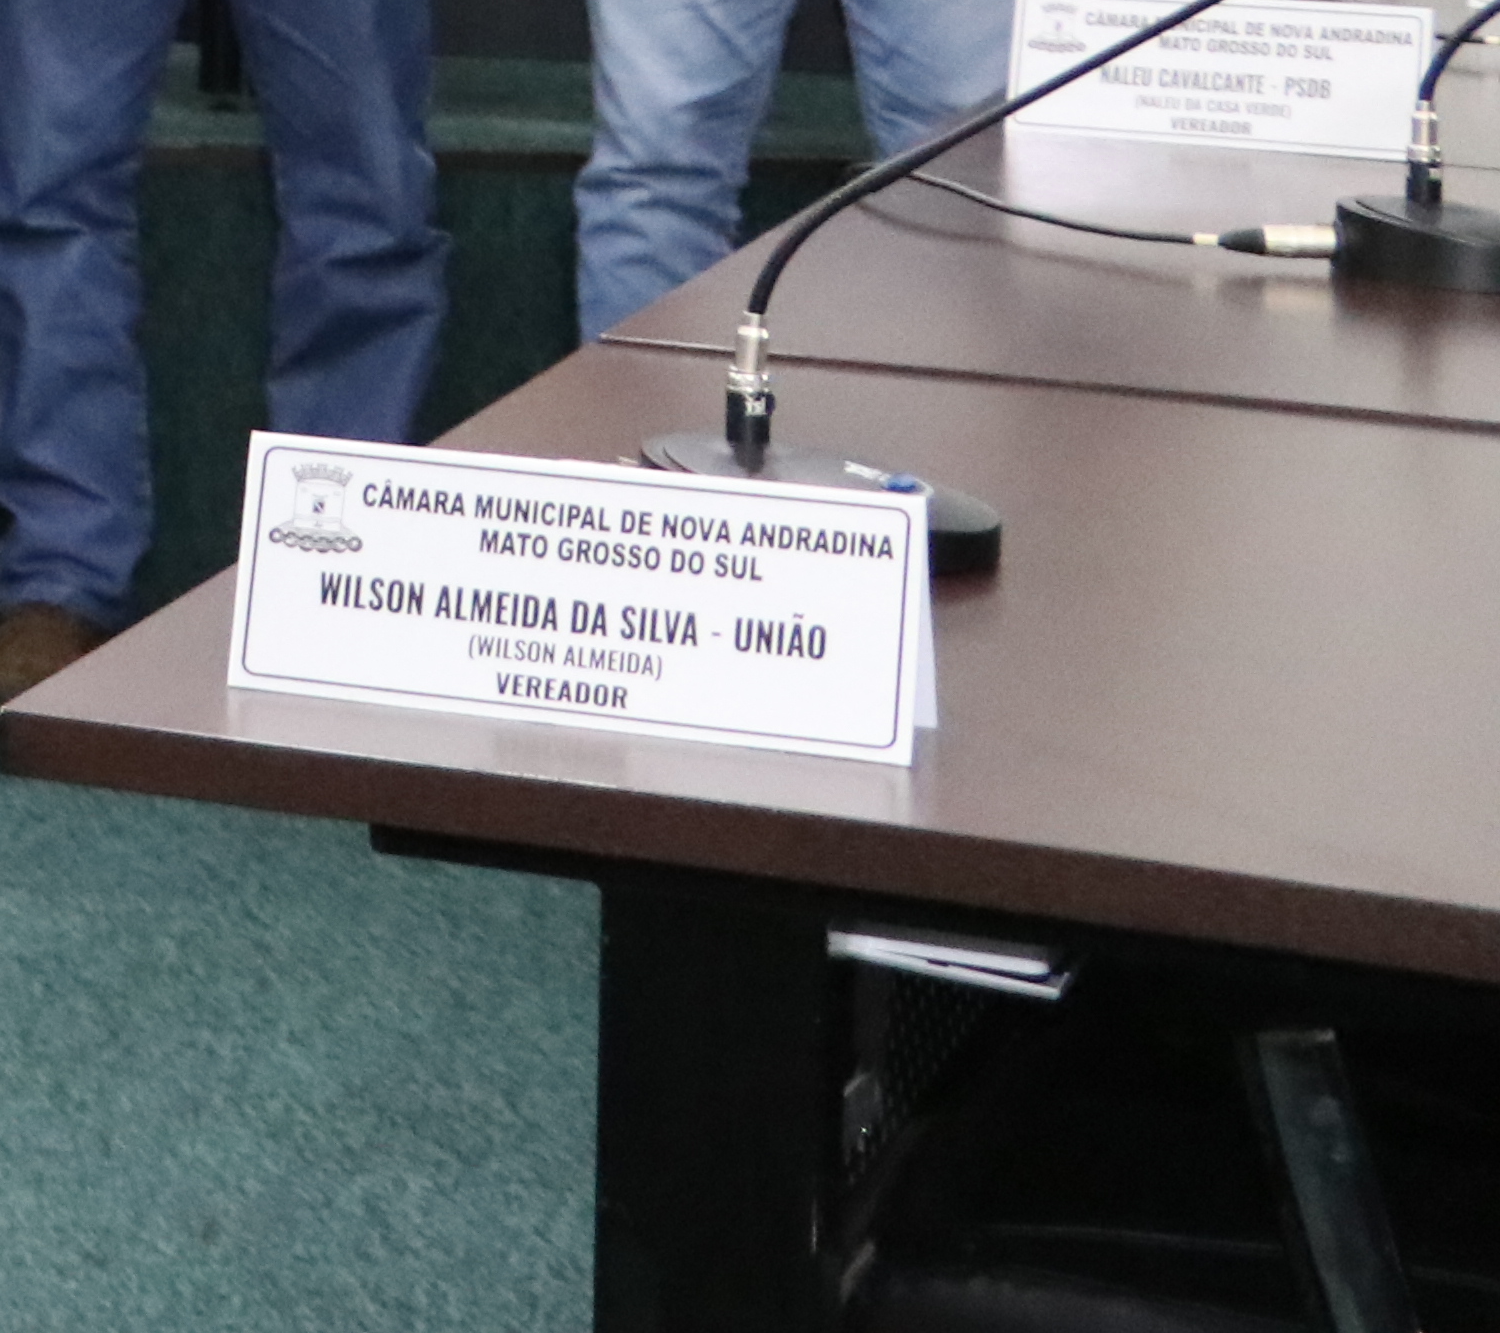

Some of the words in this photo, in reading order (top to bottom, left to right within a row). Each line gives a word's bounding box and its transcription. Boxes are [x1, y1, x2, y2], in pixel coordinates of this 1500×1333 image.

[1246, 22, 1265, 37] DE
[1303, 44, 1334, 61] SUL
[362, 481, 466, 517] CÂMARA
[474, 493, 611, 533] MUNICIPAL
[621, 509, 653, 537] DE
[661, 512, 732, 544] NOVA
[740, 519, 895, 560] ANDRADINA
[479, 528, 547, 559] MATO
[557, 535, 660, 571] GROSSO
[670, 546, 705, 575] DO
[713, 550, 763, 581] SUL
[319, 569, 425, 617] WILSON
[435, 581, 559, 632] ALMEIDA
[570, 598, 608, 637] DA
[620, 603, 699, 647] SILVA
[733, 612, 827, 661] UNIÃO
[468, 634, 556, 666] (WILSON
[563, 644, 664, 681] ALMEIDA)
[495, 672, 629, 710] VEREADOR
